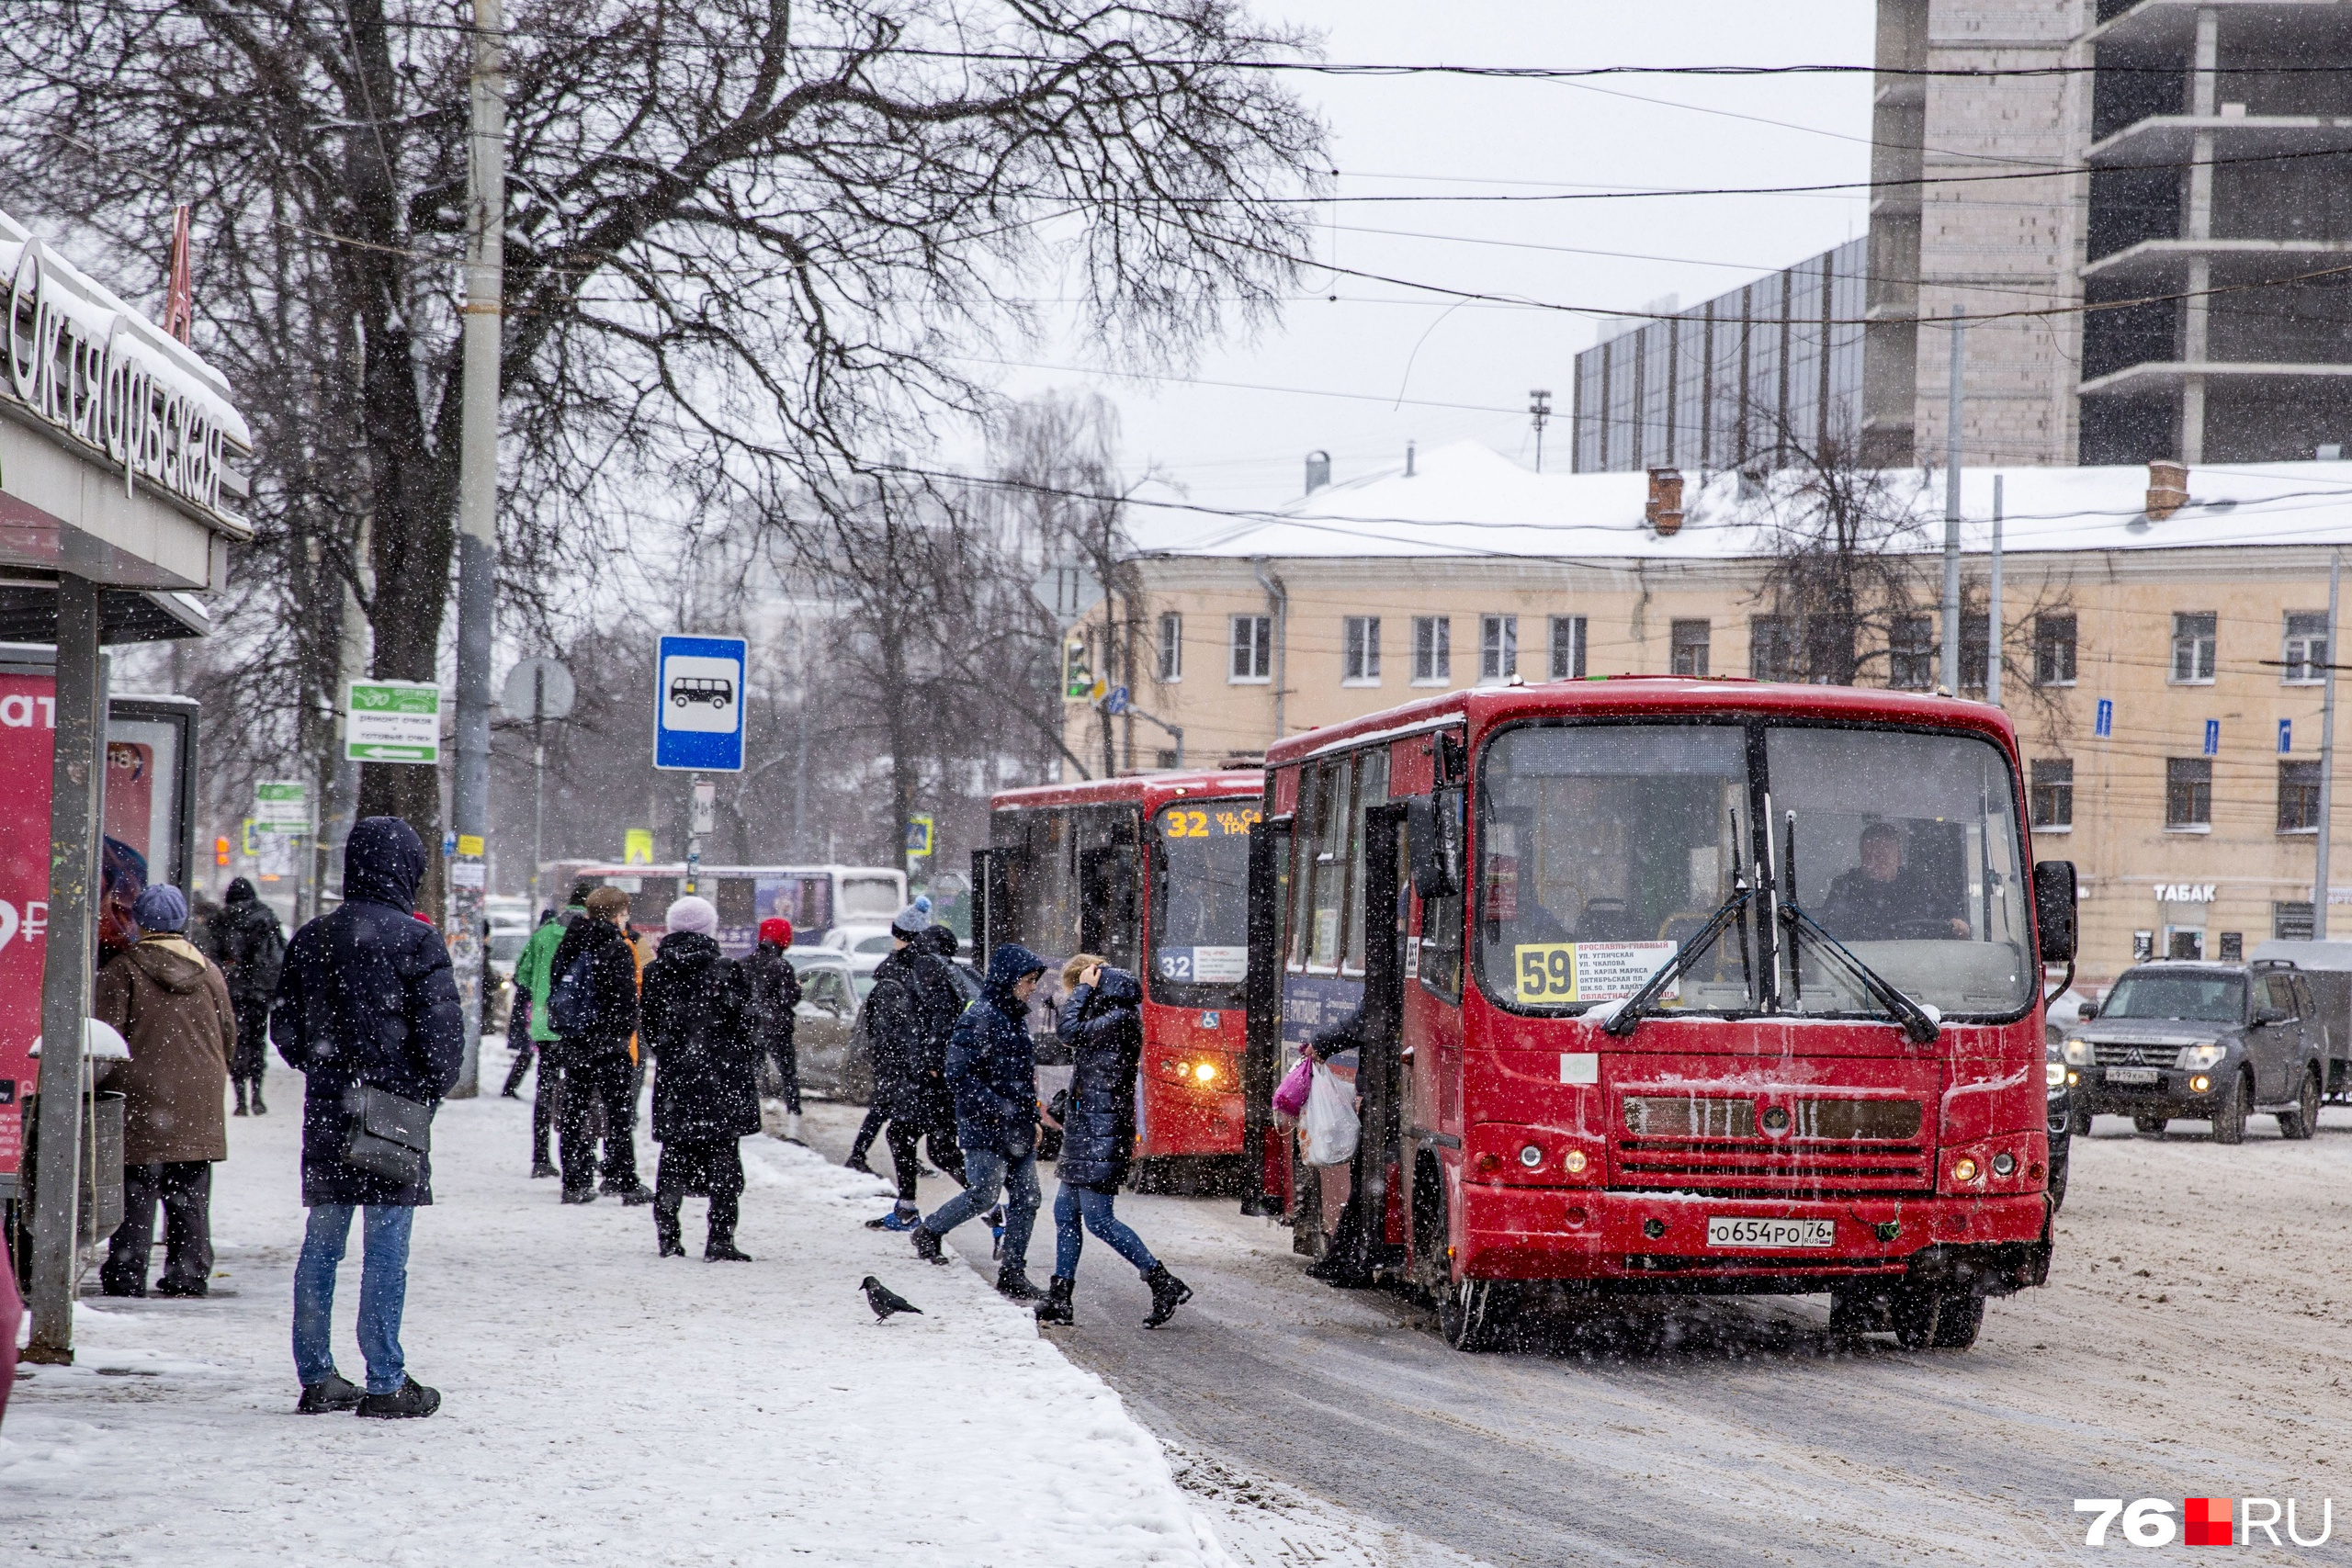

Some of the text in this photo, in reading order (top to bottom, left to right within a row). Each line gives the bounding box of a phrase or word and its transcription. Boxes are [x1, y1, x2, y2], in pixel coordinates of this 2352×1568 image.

[8, 236, 224, 511] Октябрьская
[1167, 810, 1209, 838] 32
[2154, 885, 2217, 902] ТАБАК
[1578, 941, 1668, 951] ЯРОСЛАВЛЬ-ГЛАВНЫЙ
[1161, 956, 1191, 977] 32
[1521, 950, 1572, 995] 59
[1580, 992, 1629, 1000] ОБЛАСТНАЯ
[1716, 1222, 1826, 1243] О654РО 76
